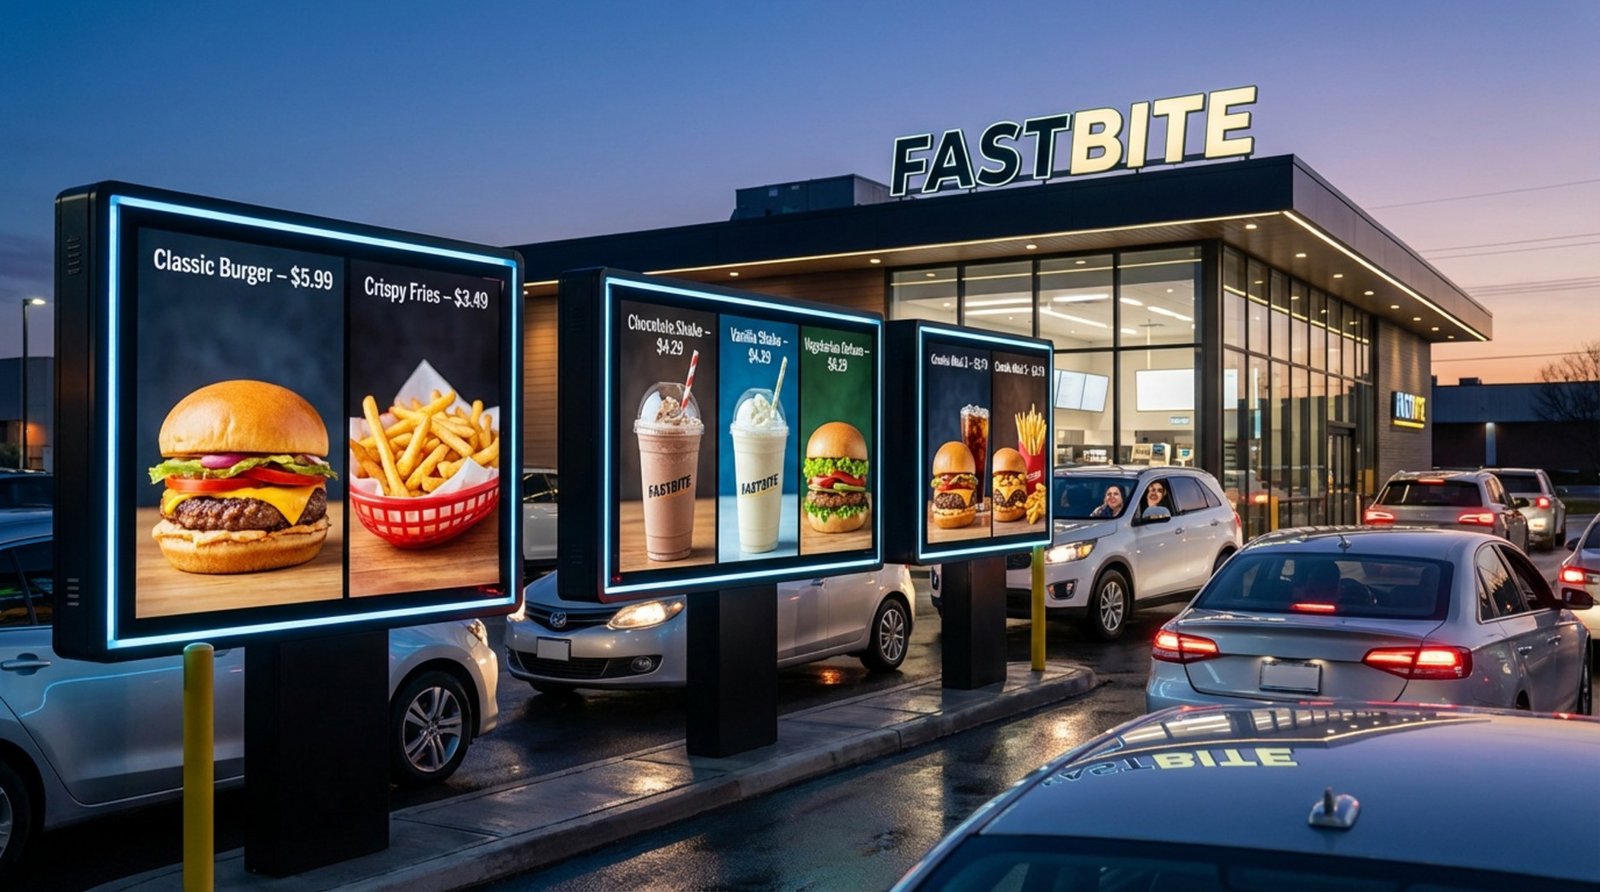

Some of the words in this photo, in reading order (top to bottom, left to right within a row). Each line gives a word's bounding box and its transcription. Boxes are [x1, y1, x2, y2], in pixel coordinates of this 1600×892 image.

[890, 85, 1258, 197] FASTBITE
[153, 247, 215, 276] Classic
[219, 256, 273, 286] Burger
[290, 265, 334, 291] $5.99
[364, 275, 407, 304] Crispy
[409, 281, 440, 304] Fries
[454, 287, 489, 309] $3.49
[656, 337, 684, 356] $4.29
